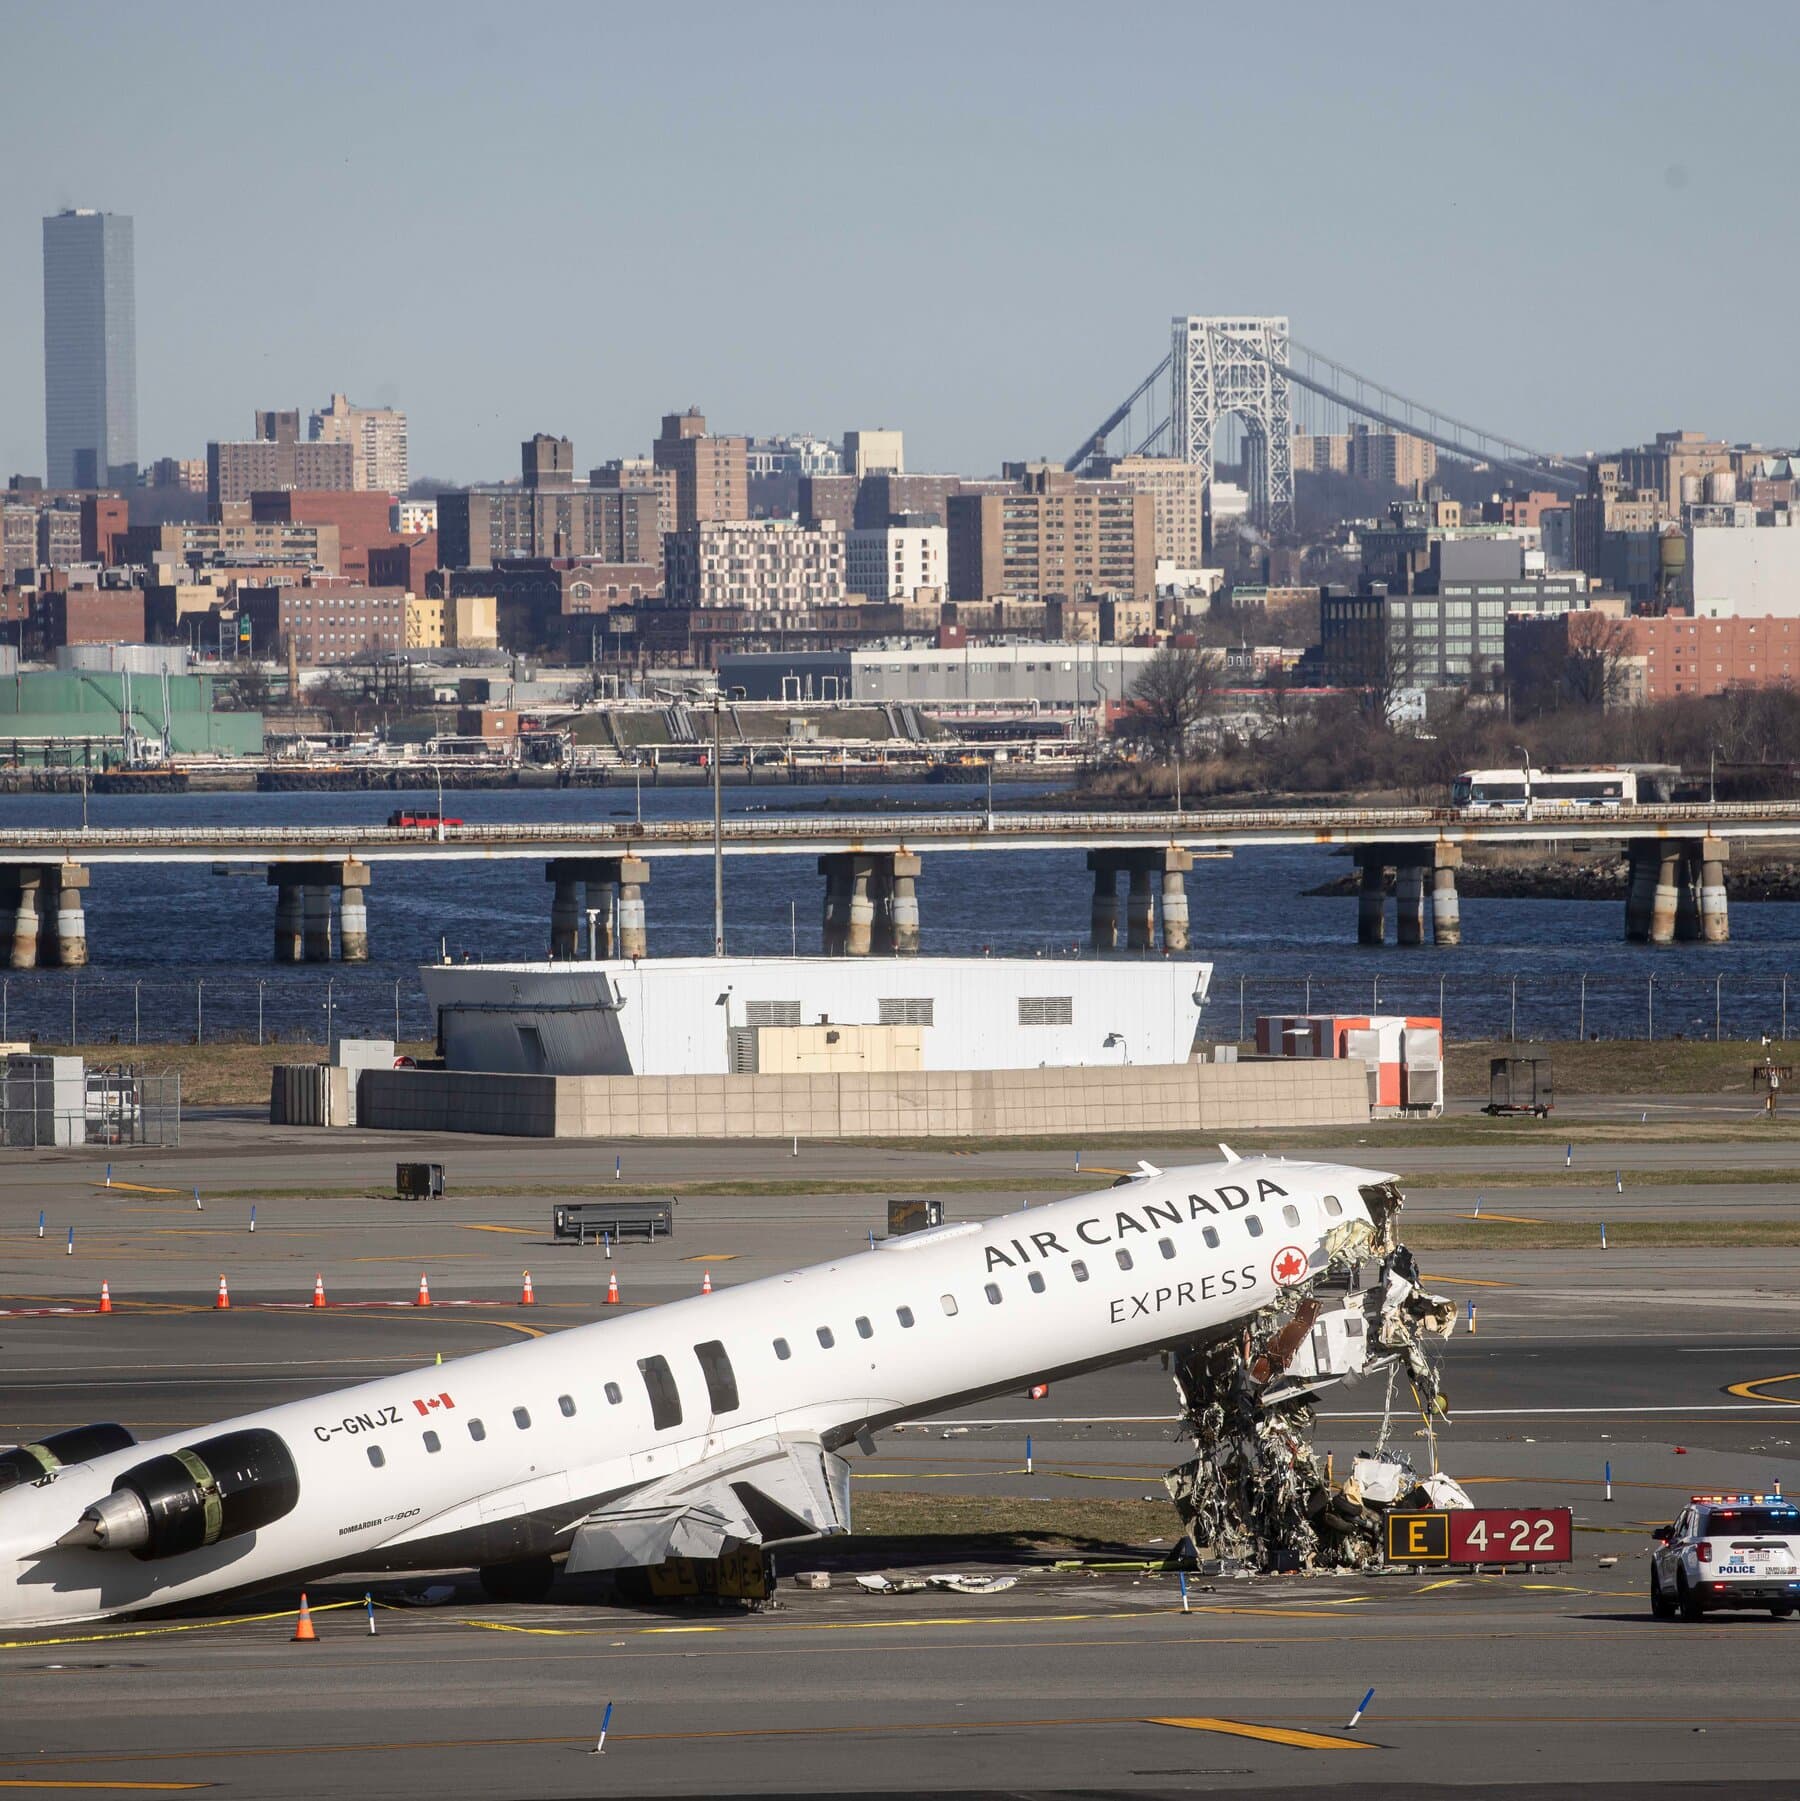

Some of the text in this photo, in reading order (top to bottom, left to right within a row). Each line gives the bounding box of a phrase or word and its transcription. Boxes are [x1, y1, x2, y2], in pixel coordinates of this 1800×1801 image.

[984, 1178, 1288, 1272] AIR CANADA
[1110, 1265, 1257, 1324] EXPRESS
[314, 1406, 404, 1442] C-GNJZ
[339, 1519, 382, 1536] BOMBARDIER
[1409, 1519, 1554, 1552] E 4-22
[1718, 1565, 1756, 1574] POLICE
